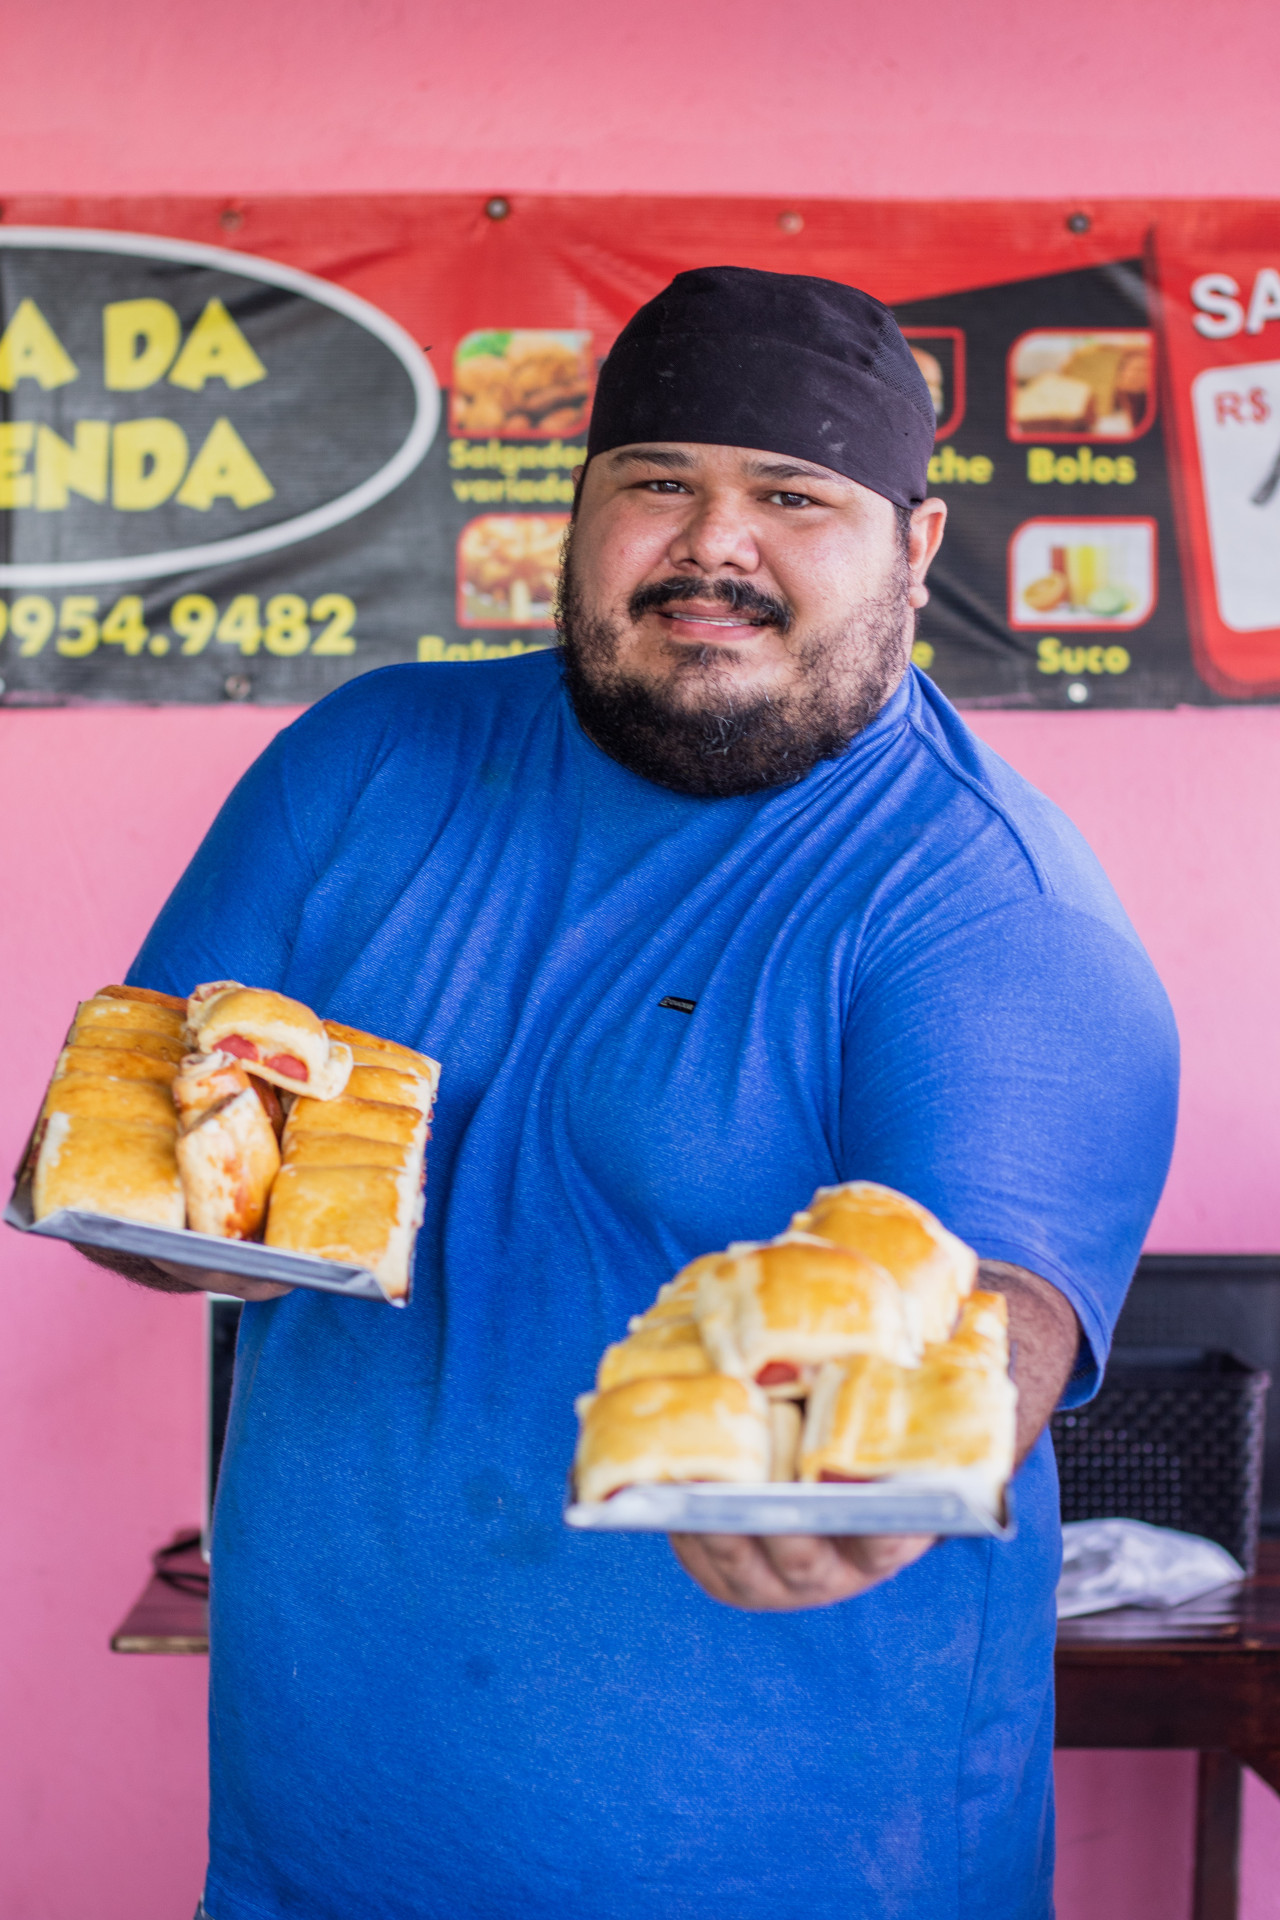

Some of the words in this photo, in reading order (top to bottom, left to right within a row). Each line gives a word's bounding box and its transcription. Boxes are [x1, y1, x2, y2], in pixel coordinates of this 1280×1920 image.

[103, 298, 267, 391] DA
[1213, 386, 1270, 424] R$
[1028, 446, 1137, 484] Bolos
[452, 473, 575, 502] variado
[0, 593, 357, 657] 954.9482
[1037, 637, 1130, 675] Suco
